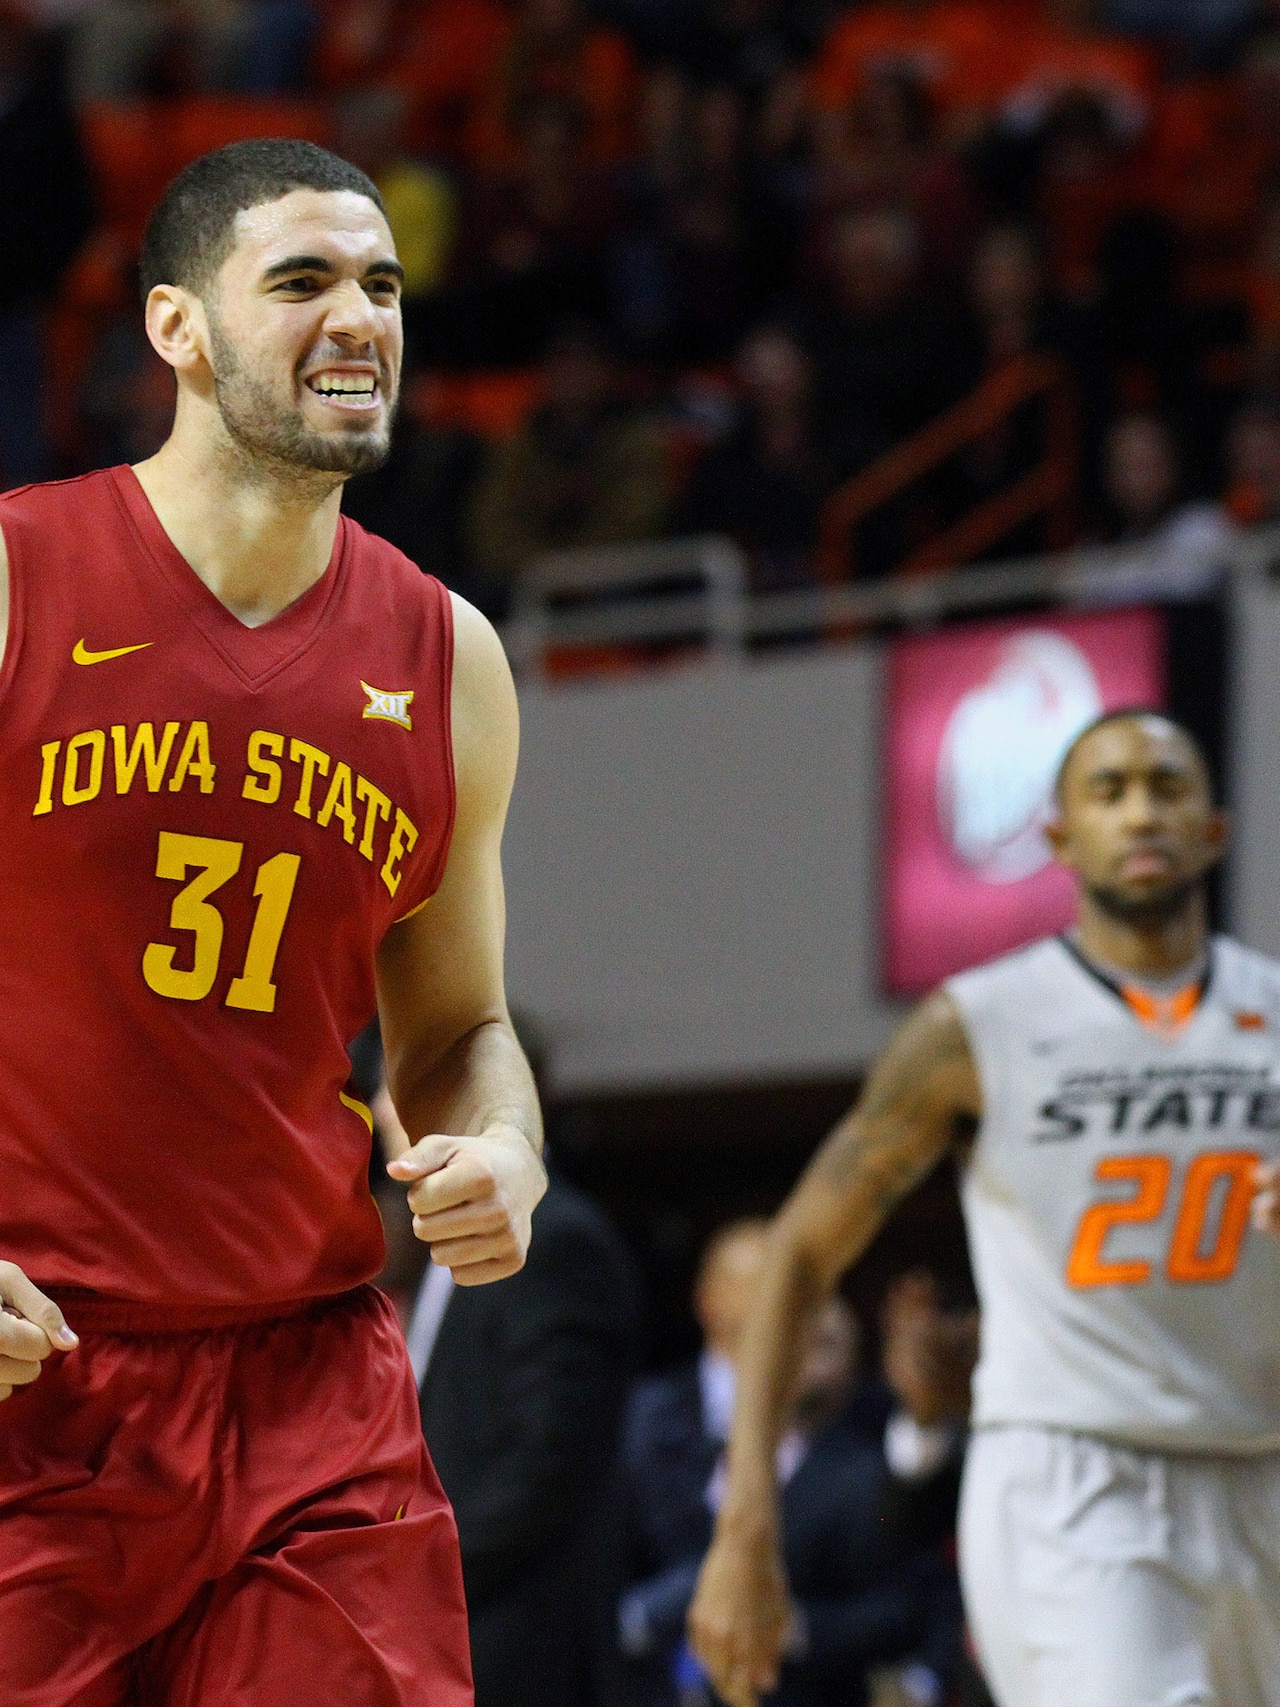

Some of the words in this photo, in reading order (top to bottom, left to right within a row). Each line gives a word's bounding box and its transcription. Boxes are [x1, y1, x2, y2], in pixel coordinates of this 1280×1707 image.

[32, 721, 216, 816] IOWA
[242, 729, 419, 898] STATE
[141, 830, 301, 1013] 31
[1065, 1152, 1261, 1288] 20
